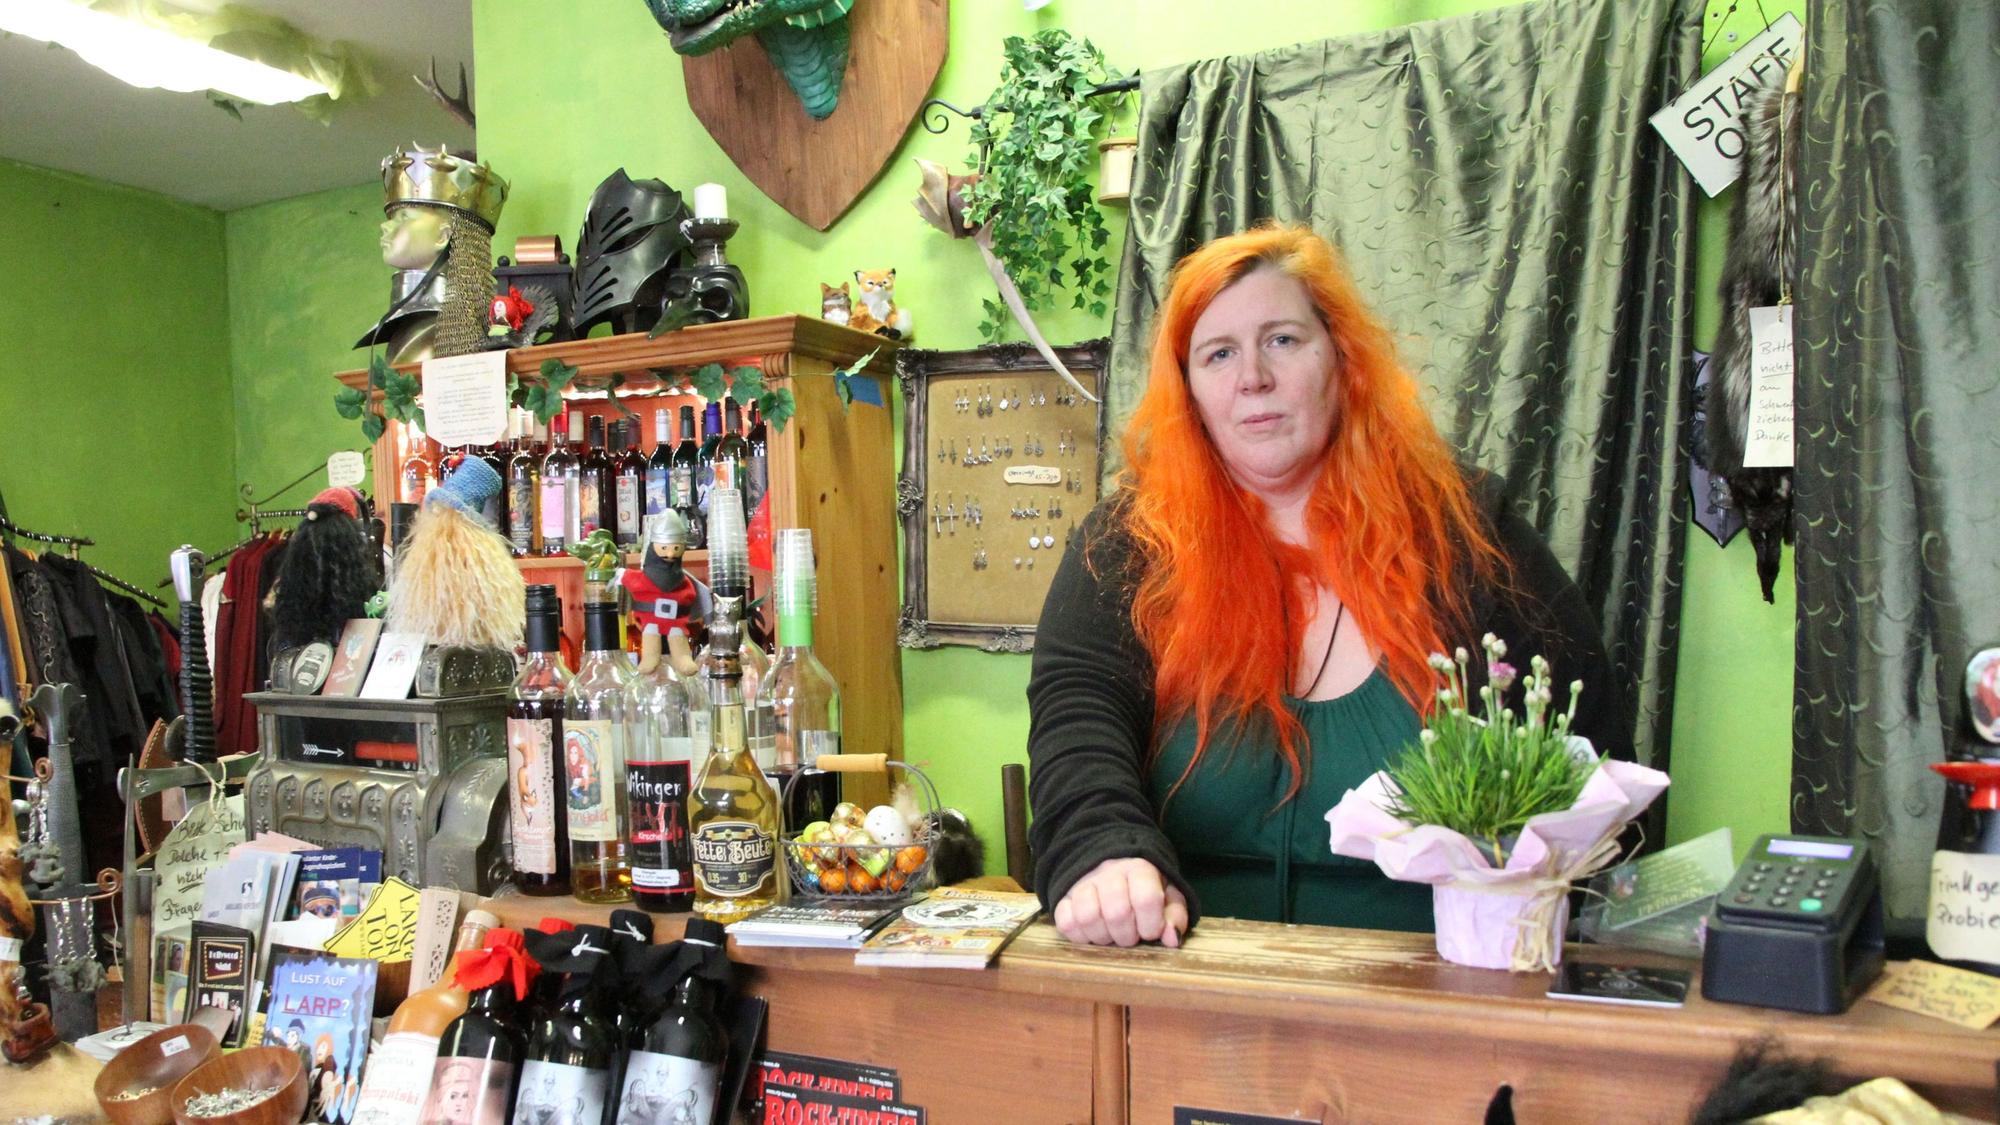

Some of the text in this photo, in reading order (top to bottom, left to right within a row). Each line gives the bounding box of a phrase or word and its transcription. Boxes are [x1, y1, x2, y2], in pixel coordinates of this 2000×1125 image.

[1683, 37, 1791, 141] STAFF
[1760, 361, 1793, 374] nicht
[1933, 868, 2000, 903] Trinkge
[1936, 905, 2000, 929] Probie
[367, 907, 387, 960] TOU
[291, 971, 348, 986] LUST AUF
[283, 994, 350, 1017] LARP?
[764, 1094, 917, 1125] ROCK-TIM
